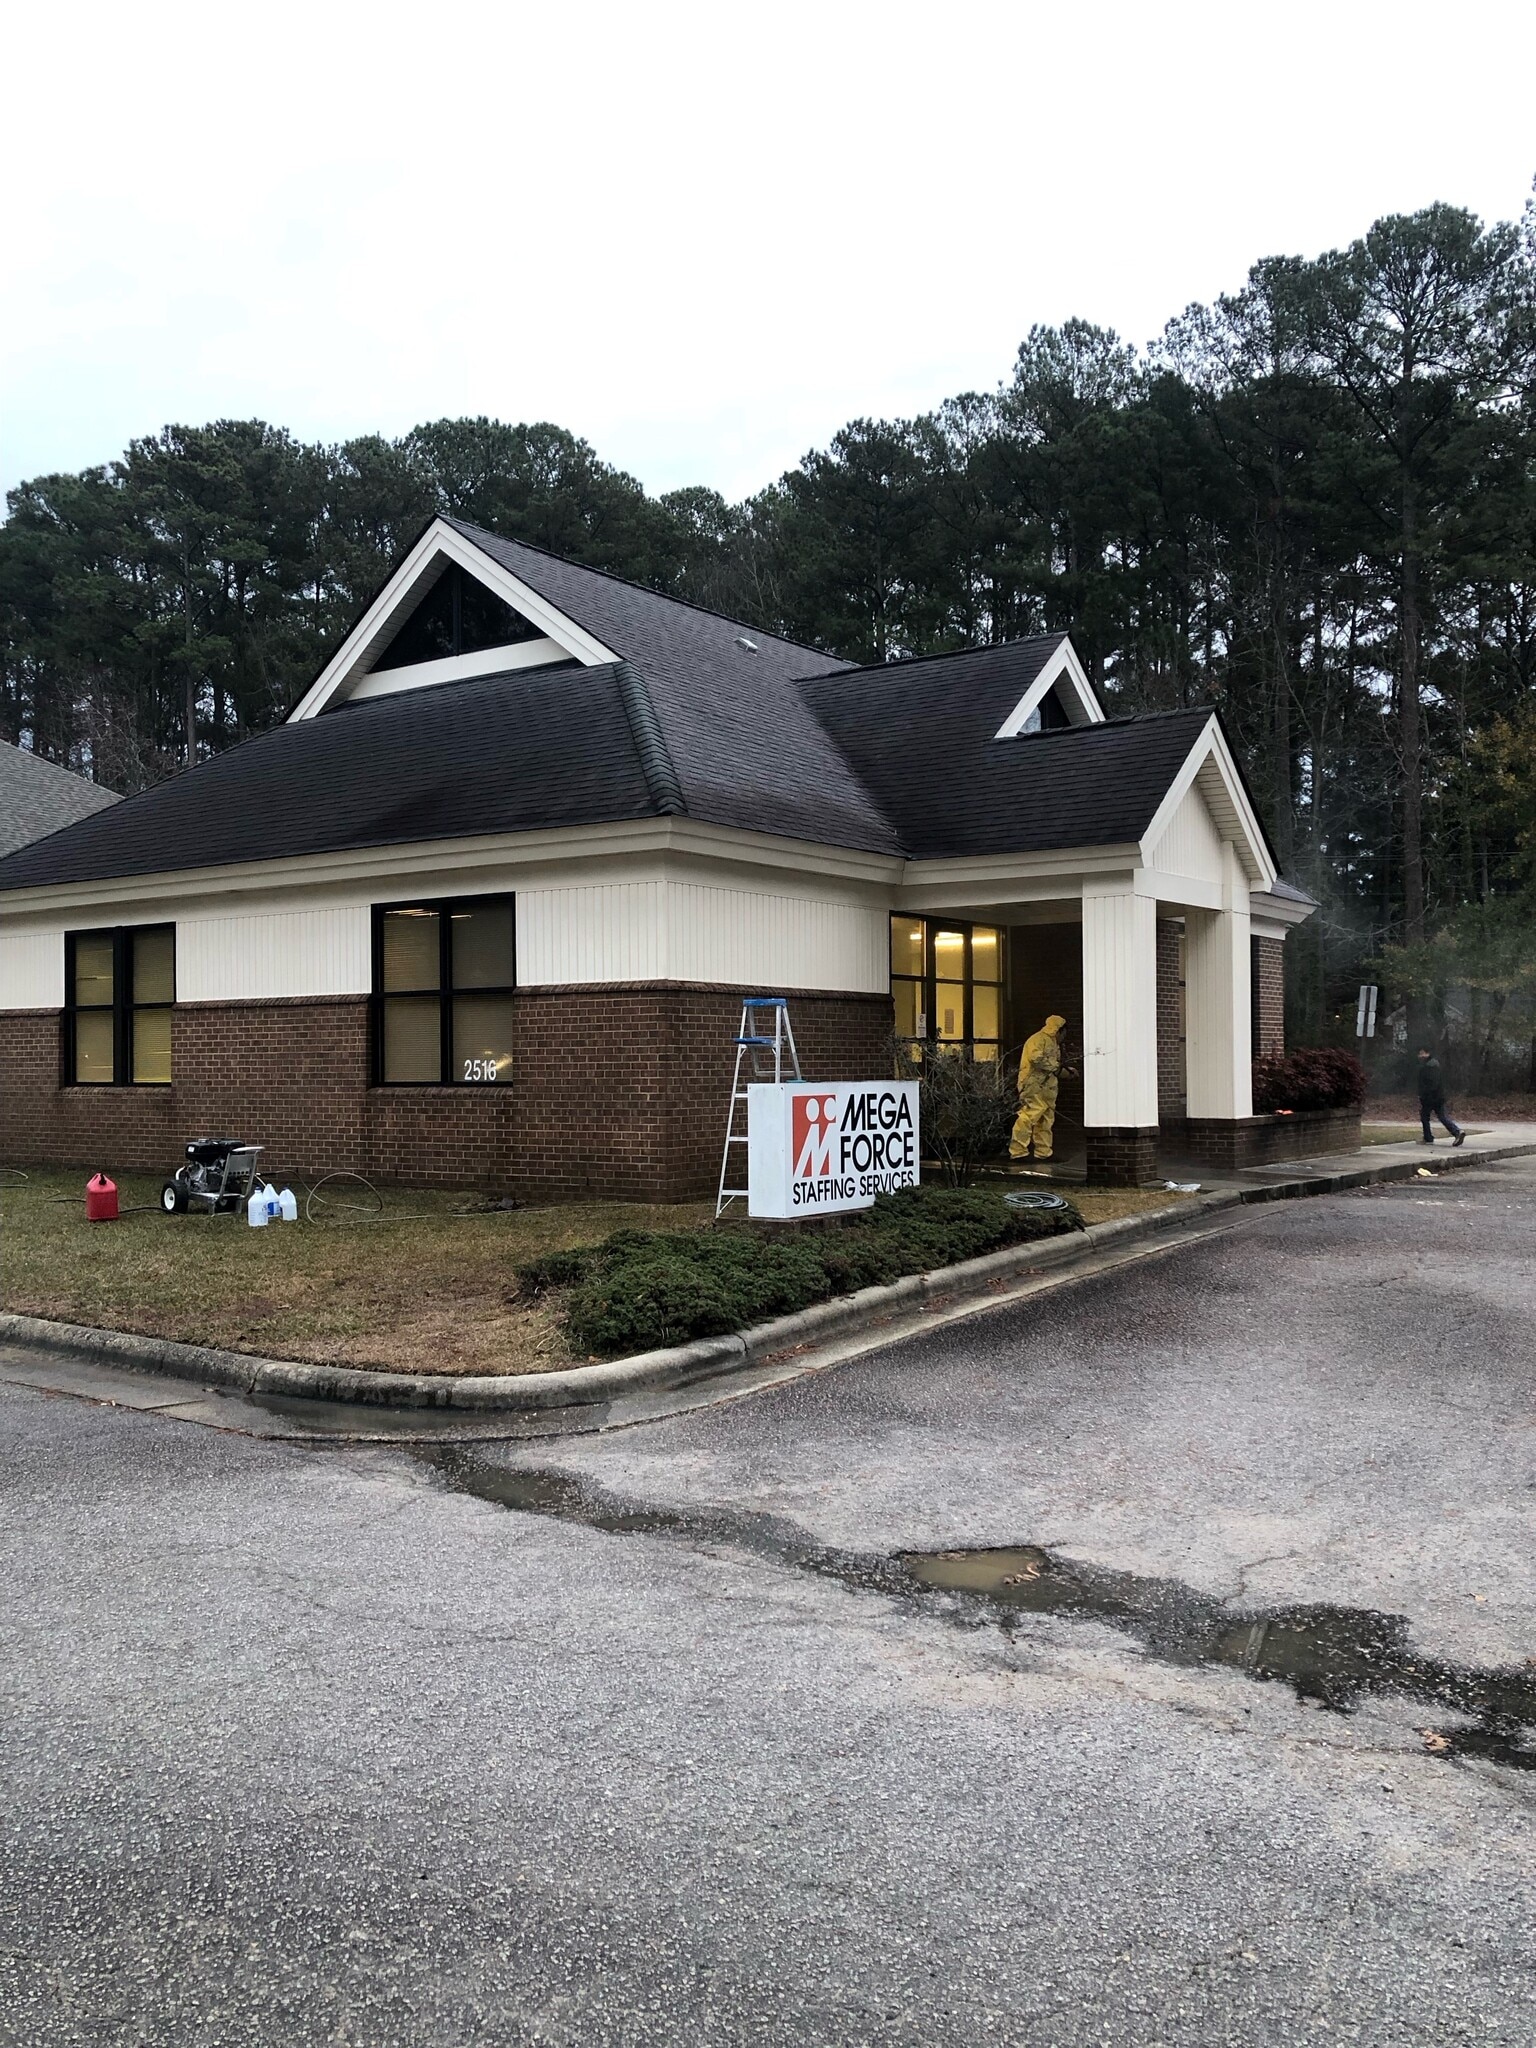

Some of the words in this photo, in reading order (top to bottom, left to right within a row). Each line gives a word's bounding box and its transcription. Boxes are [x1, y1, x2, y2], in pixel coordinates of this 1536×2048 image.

[464, 1059, 497, 1081] 2516
[840, 1092, 913, 1132] MEGA
[840, 1131, 914, 1174] FORCE
[793, 1177, 856, 1205] STAFFING
[859, 1170, 914, 1197] SERVICES
